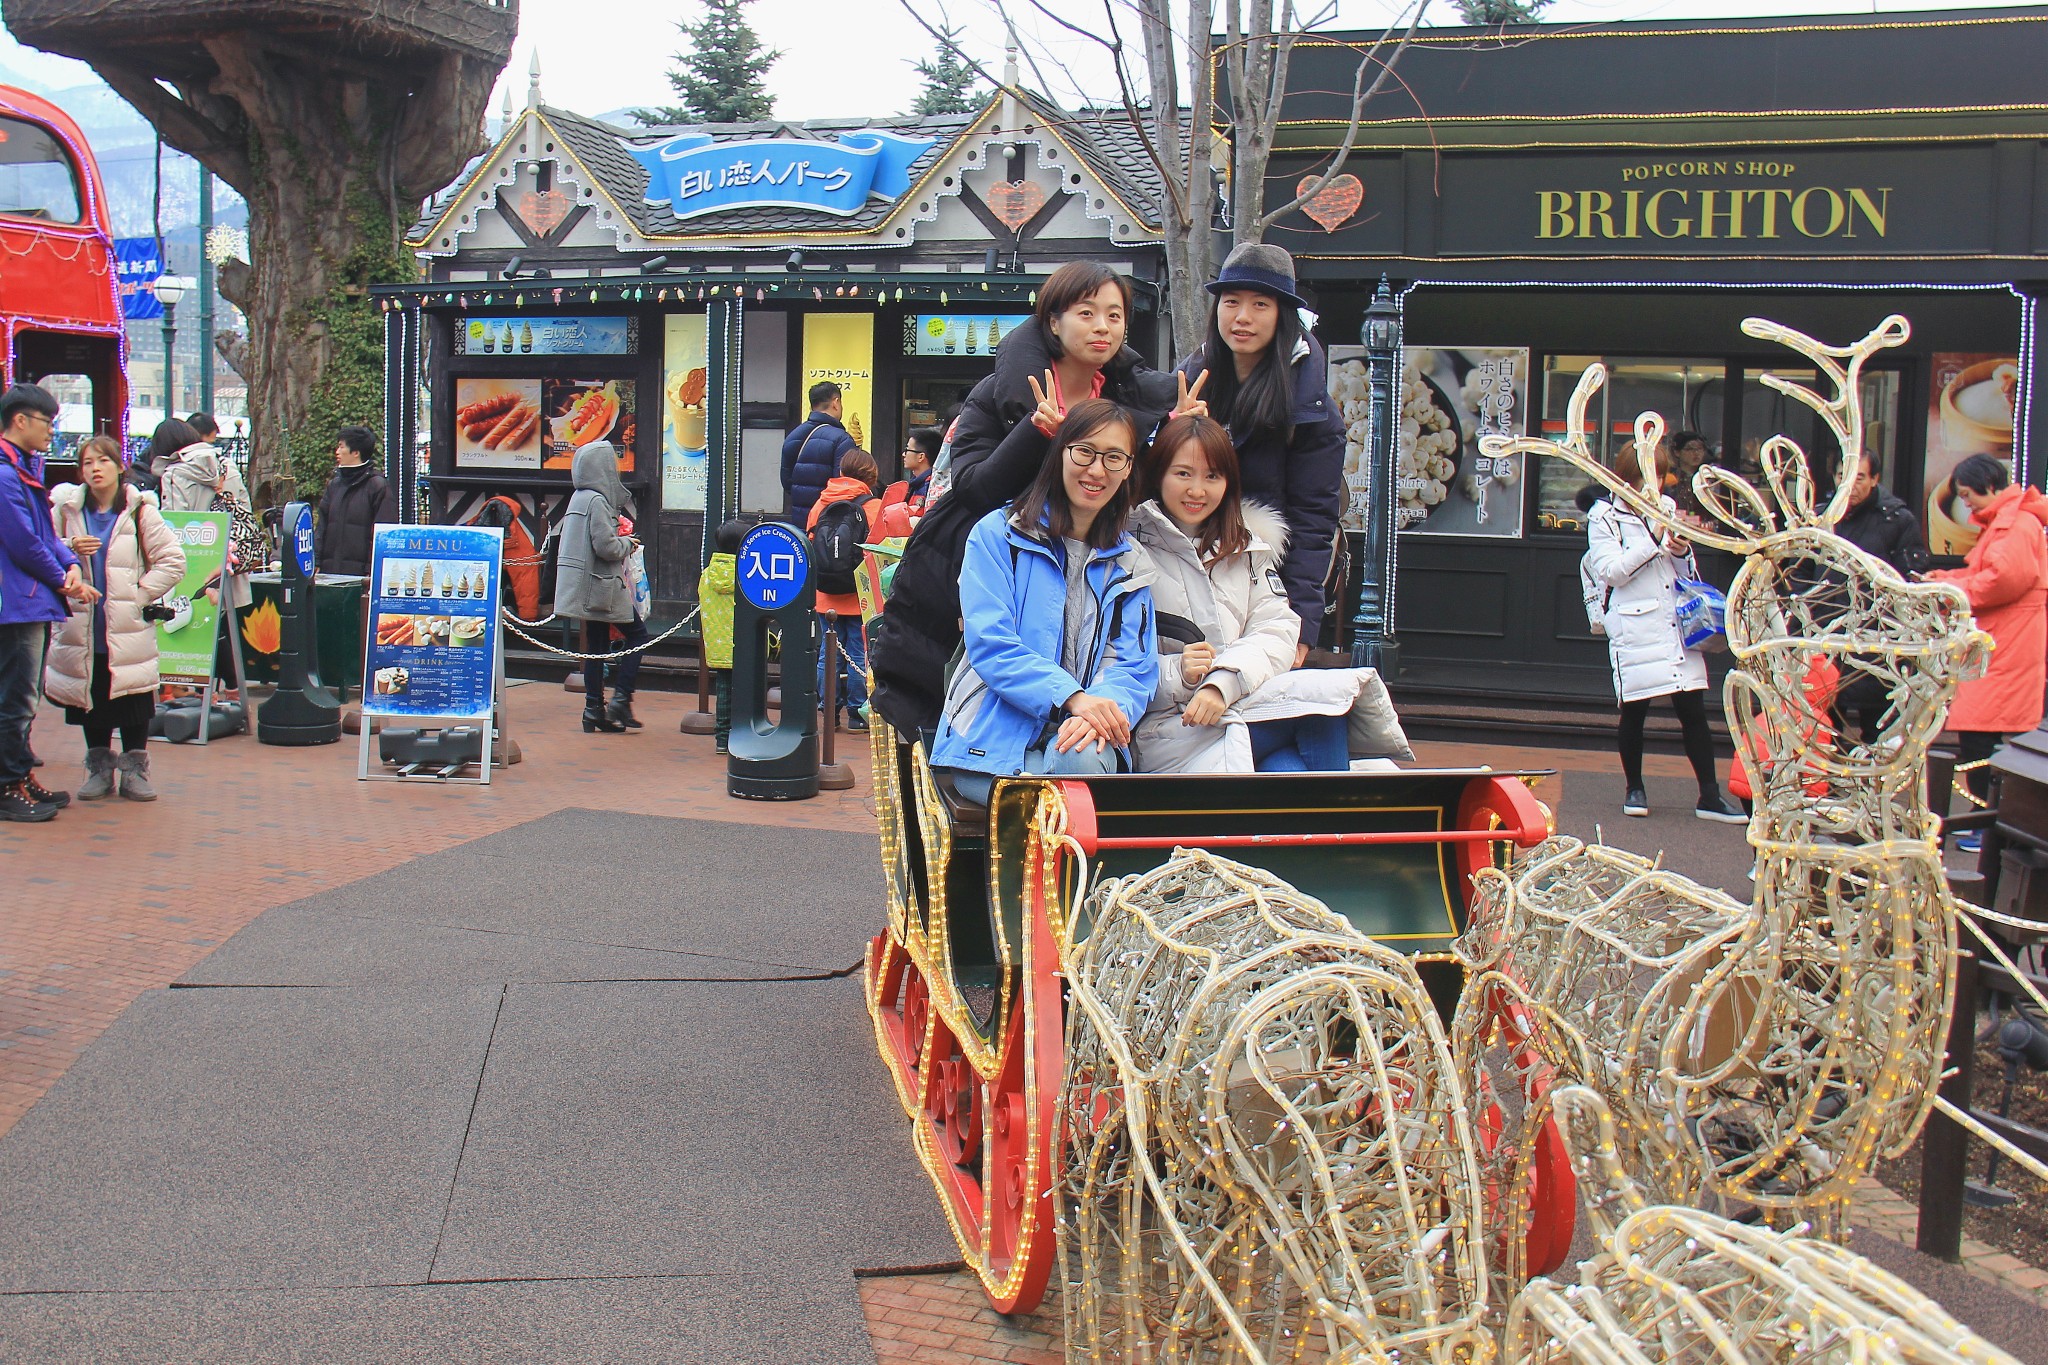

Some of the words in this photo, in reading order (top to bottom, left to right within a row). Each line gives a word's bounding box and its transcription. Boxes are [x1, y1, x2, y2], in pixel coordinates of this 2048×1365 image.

[680, 159, 853, 199] 白い恋人パーク
[1622, 161, 1728, 182] POPCORN
[1734, 161, 1796, 178] SHOP
[1534, 186, 1894, 239] BRIGHTON
[542, 325, 588, 339] 白い恋人
[809, 369, 869, 378] ソフトクリーム
[835, 382, 852, 391] ウス
[1493, 358, 1515, 476] 白さのヒは
[408, 538, 463, 552] MENU
[740, 543, 749, 560] Soft
[746, 531, 762, 546] Serve
[772, 528, 792, 544] Cream
[790, 541, 804, 564] House
[746, 551, 795, 581] 入口
[762, 588, 777, 602] IN
[413, 657, 444, 667] DRINK
